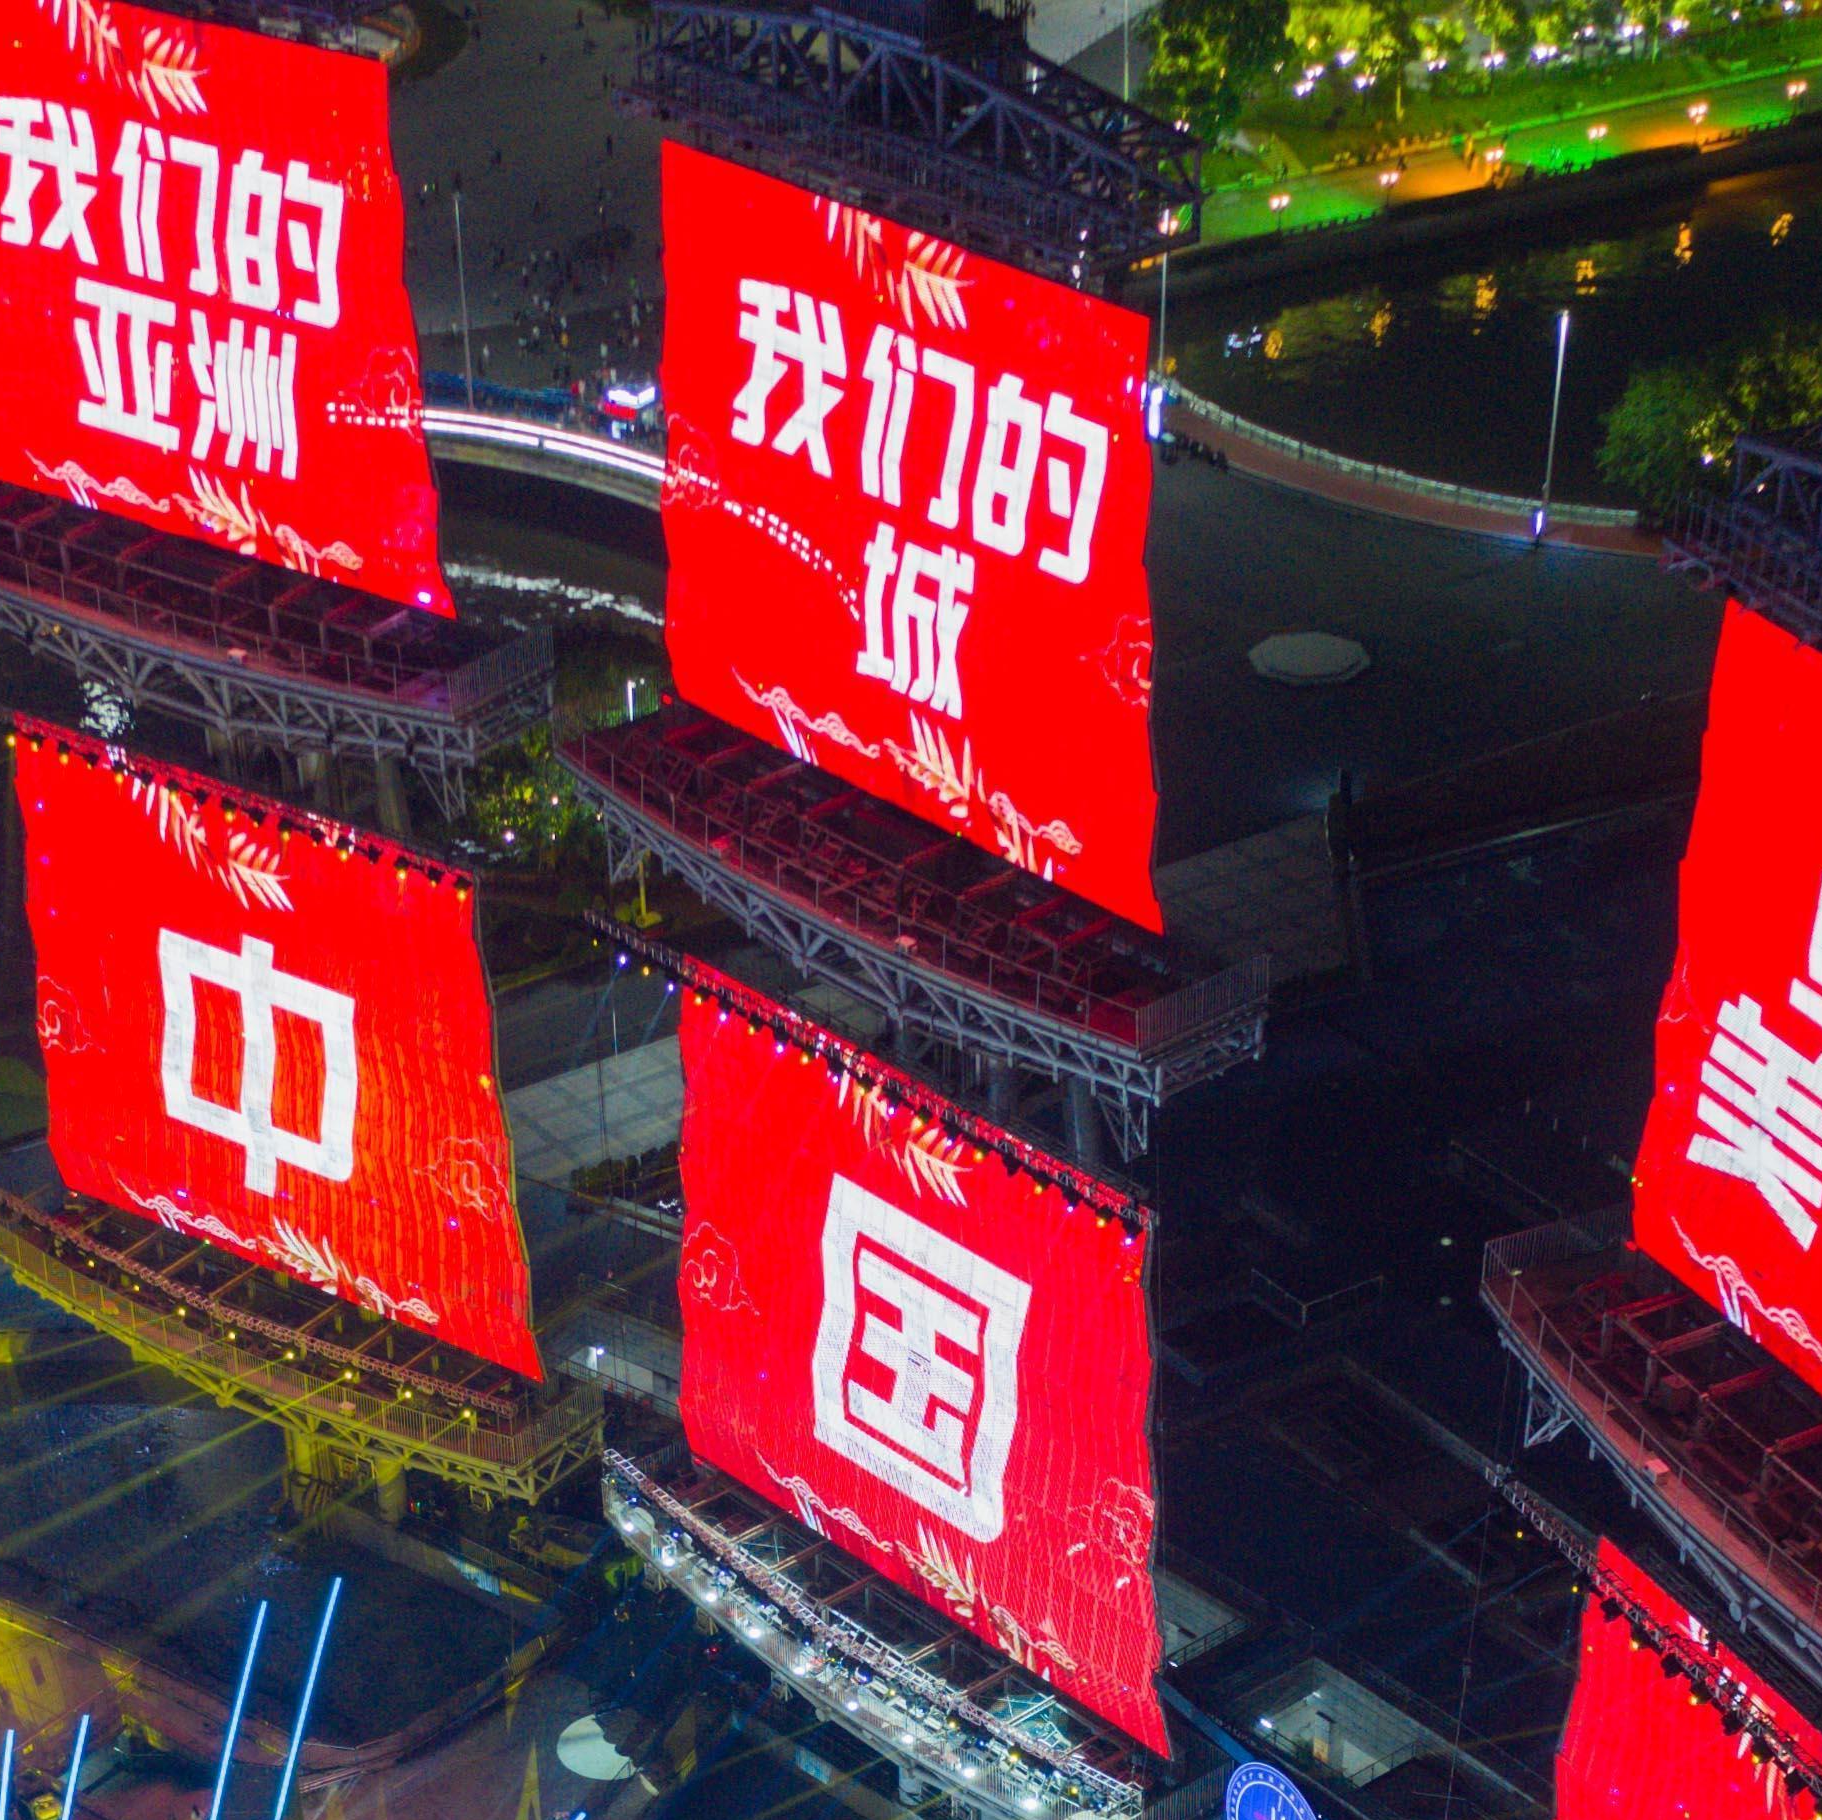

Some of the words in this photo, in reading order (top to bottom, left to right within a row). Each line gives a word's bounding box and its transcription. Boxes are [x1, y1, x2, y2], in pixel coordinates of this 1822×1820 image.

[75, 278, 298, 481] 亚洲
[732, 276, 1107, 582] 我们的
[856, 524, 975, 719] 城
[157, 928, 357, 1196] 中
[812, 1174, 1031, 1541] 国
